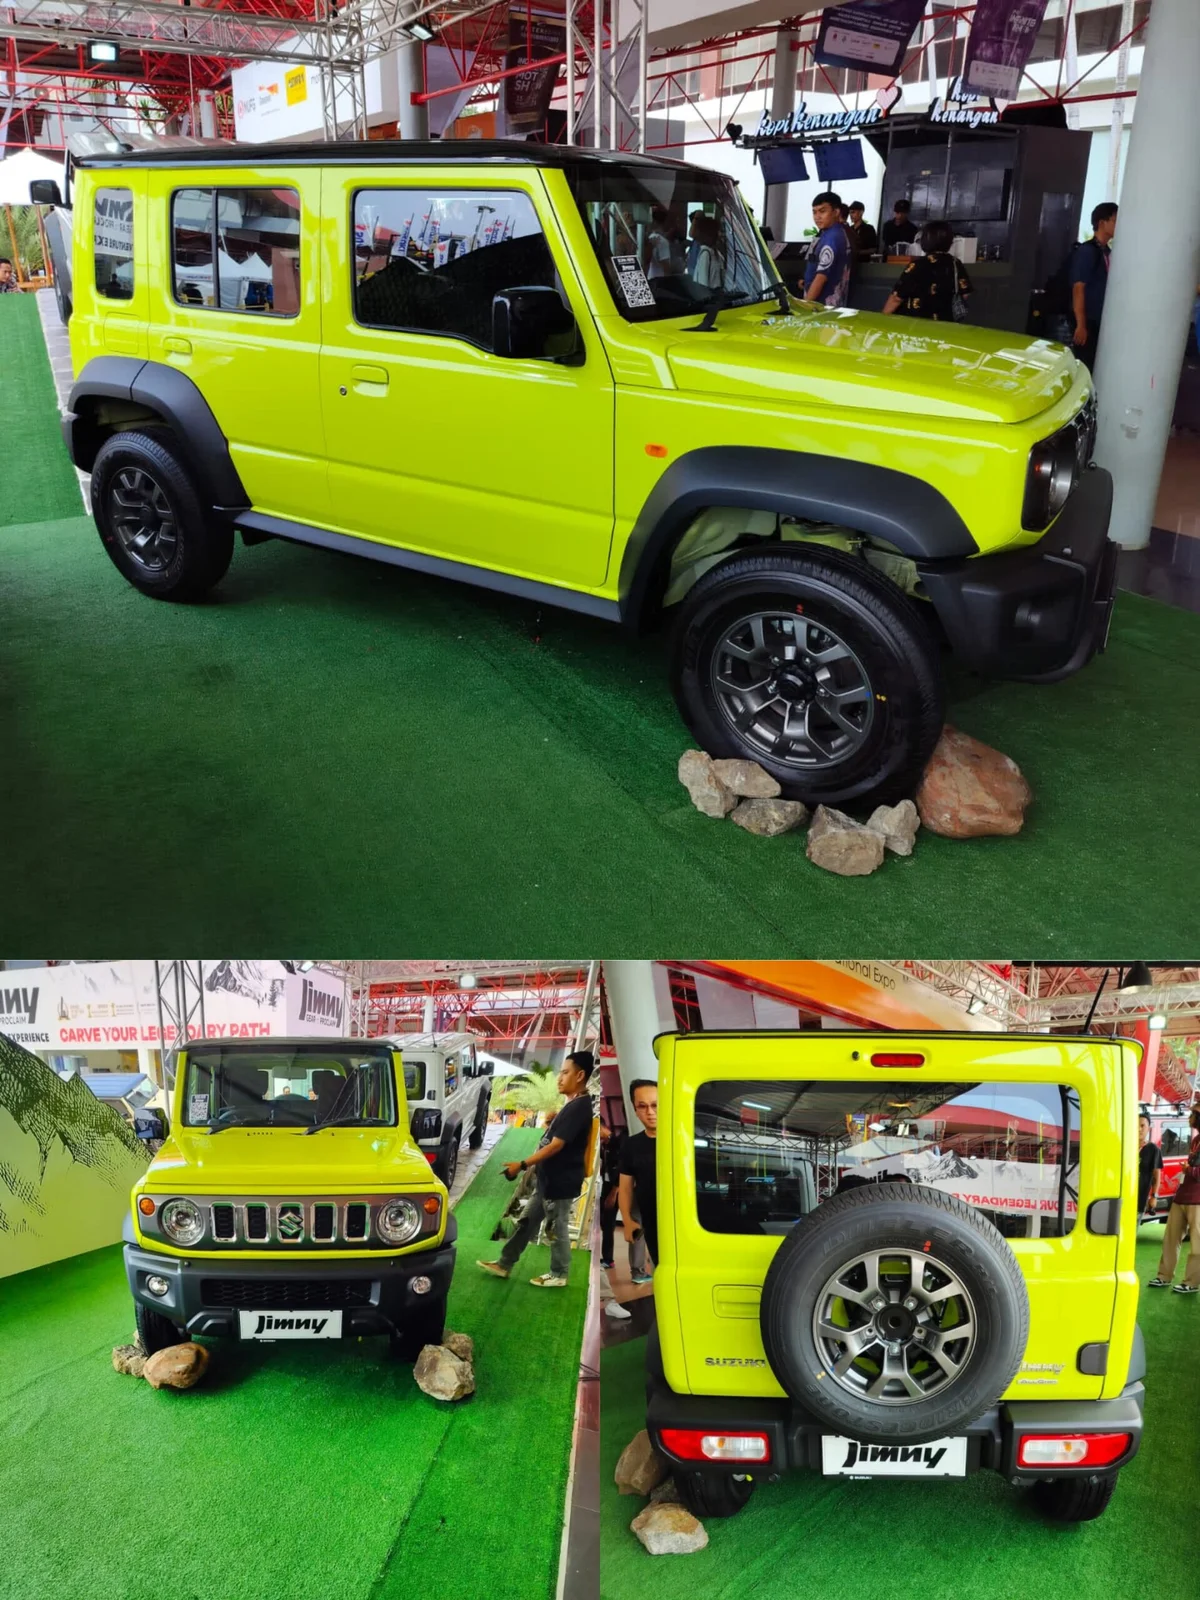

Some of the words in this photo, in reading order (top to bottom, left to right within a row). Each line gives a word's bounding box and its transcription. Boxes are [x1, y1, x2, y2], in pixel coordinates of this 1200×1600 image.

[756, 109, 789, 136] kopi
[791, 101, 879, 134] kenangan
[931, 98, 998, 128] kenangan
[873, 967, 896, 990] Expo
[299, 978, 343, 1028] Jimny
[60, 1027, 101, 1043] CARVE
[102, 1026, 137, 1042] YOUR
[230, 1022, 270, 1037] PATH
[254, 1315, 328, 1334] Jimny
[705, 1357, 766, 1368] SUZUKI
[1020, 1361, 1065, 1375] imny
[842, 1442, 947, 1468] Jimny
